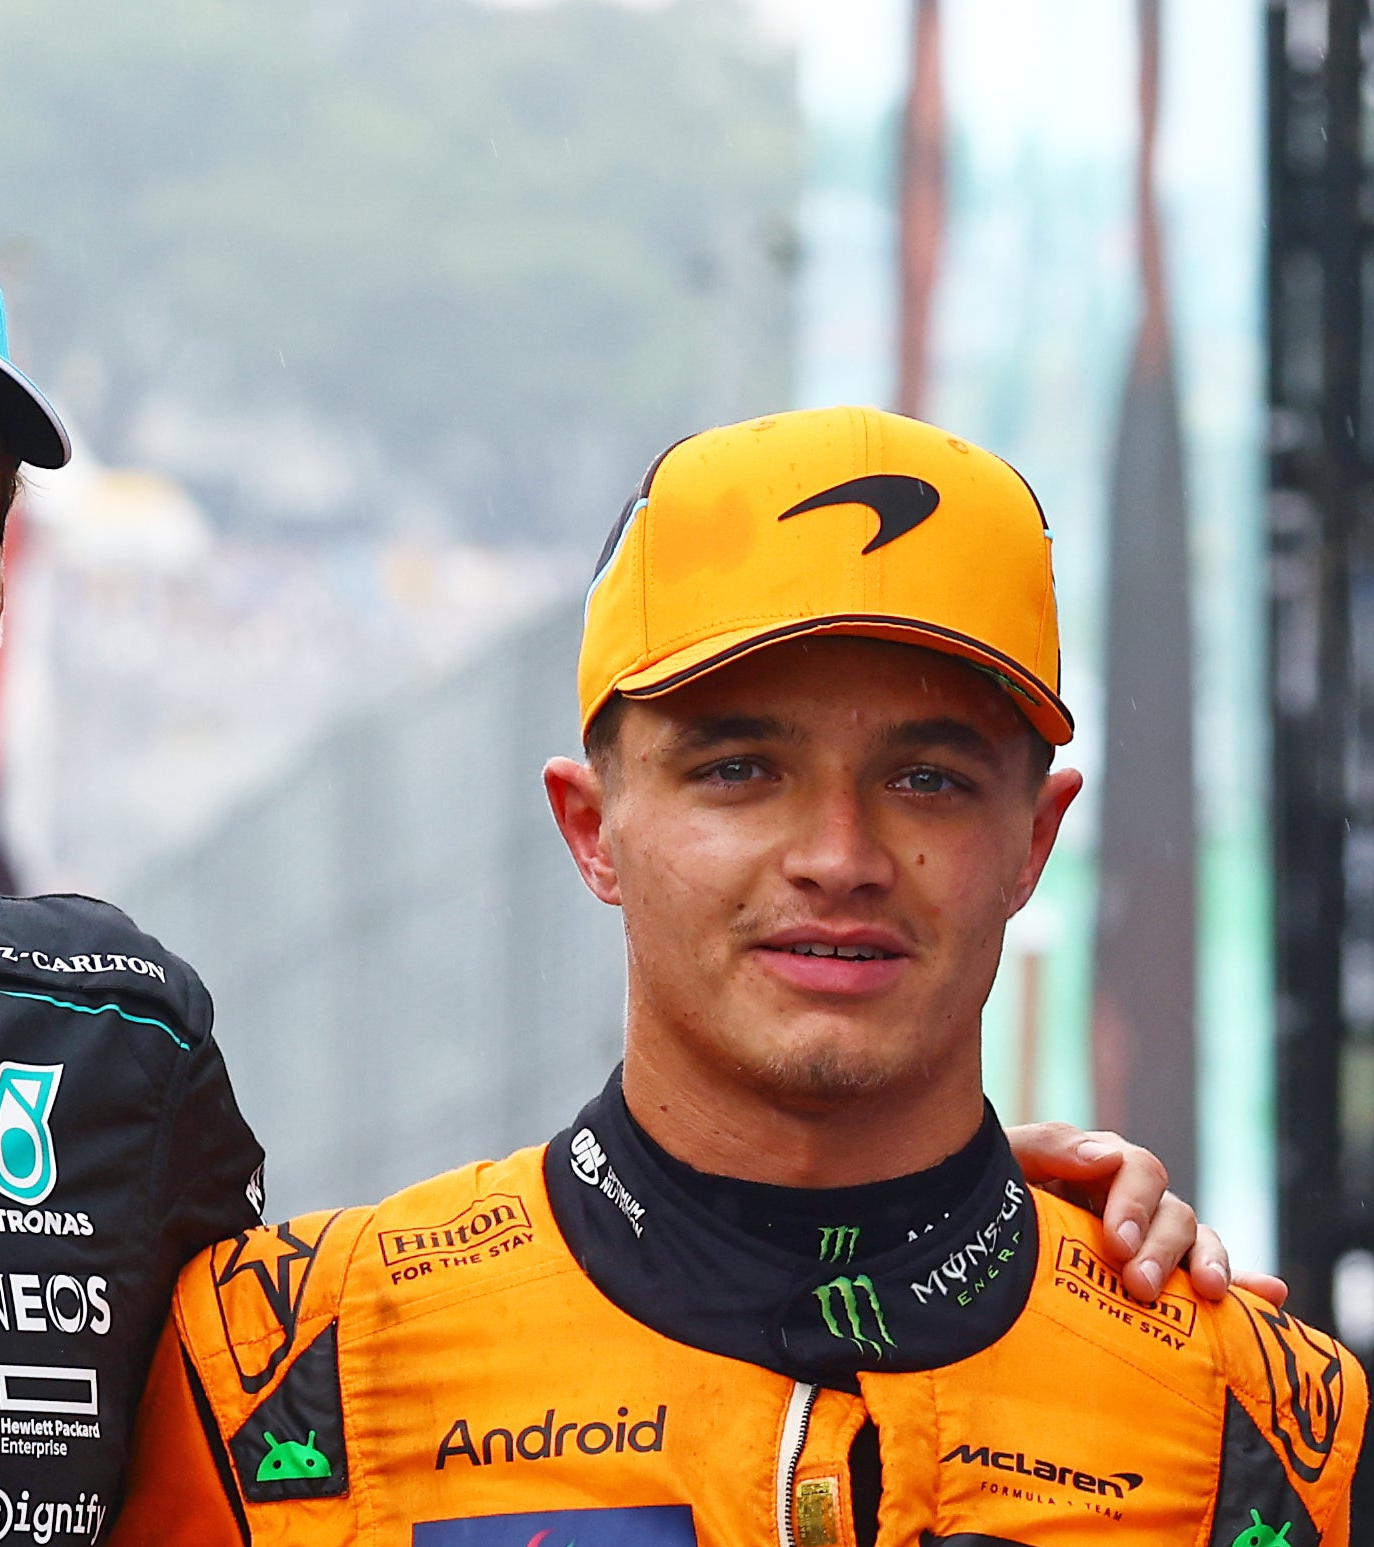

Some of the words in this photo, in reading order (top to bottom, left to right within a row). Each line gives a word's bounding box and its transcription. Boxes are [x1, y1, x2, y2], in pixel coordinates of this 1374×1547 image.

[393, 1204, 518, 1254] Hilton
[910, 1179, 1025, 1304] MONSER
[391, 1262, 433, 1286] FOR
[440, 1253, 483, 1268] THE
[489, 1232, 534, 1258] STAY
[1070, 1247, 1183, 1323] Hiln
[1055, 1277, 1091, 1303] FOR
[1098, 1299, 1134, 1326] THE
[1139, 1321, 1186, 1351] STAY
[0, 1417, 54, 1437] Hewlett
[55, 1419, 101, 1439] Packard
[0, 1437, 69, 1459] Enterprise
[434, 1404, 668, 1471] Android
[938, 1444, 1126, 1500] McLaren
